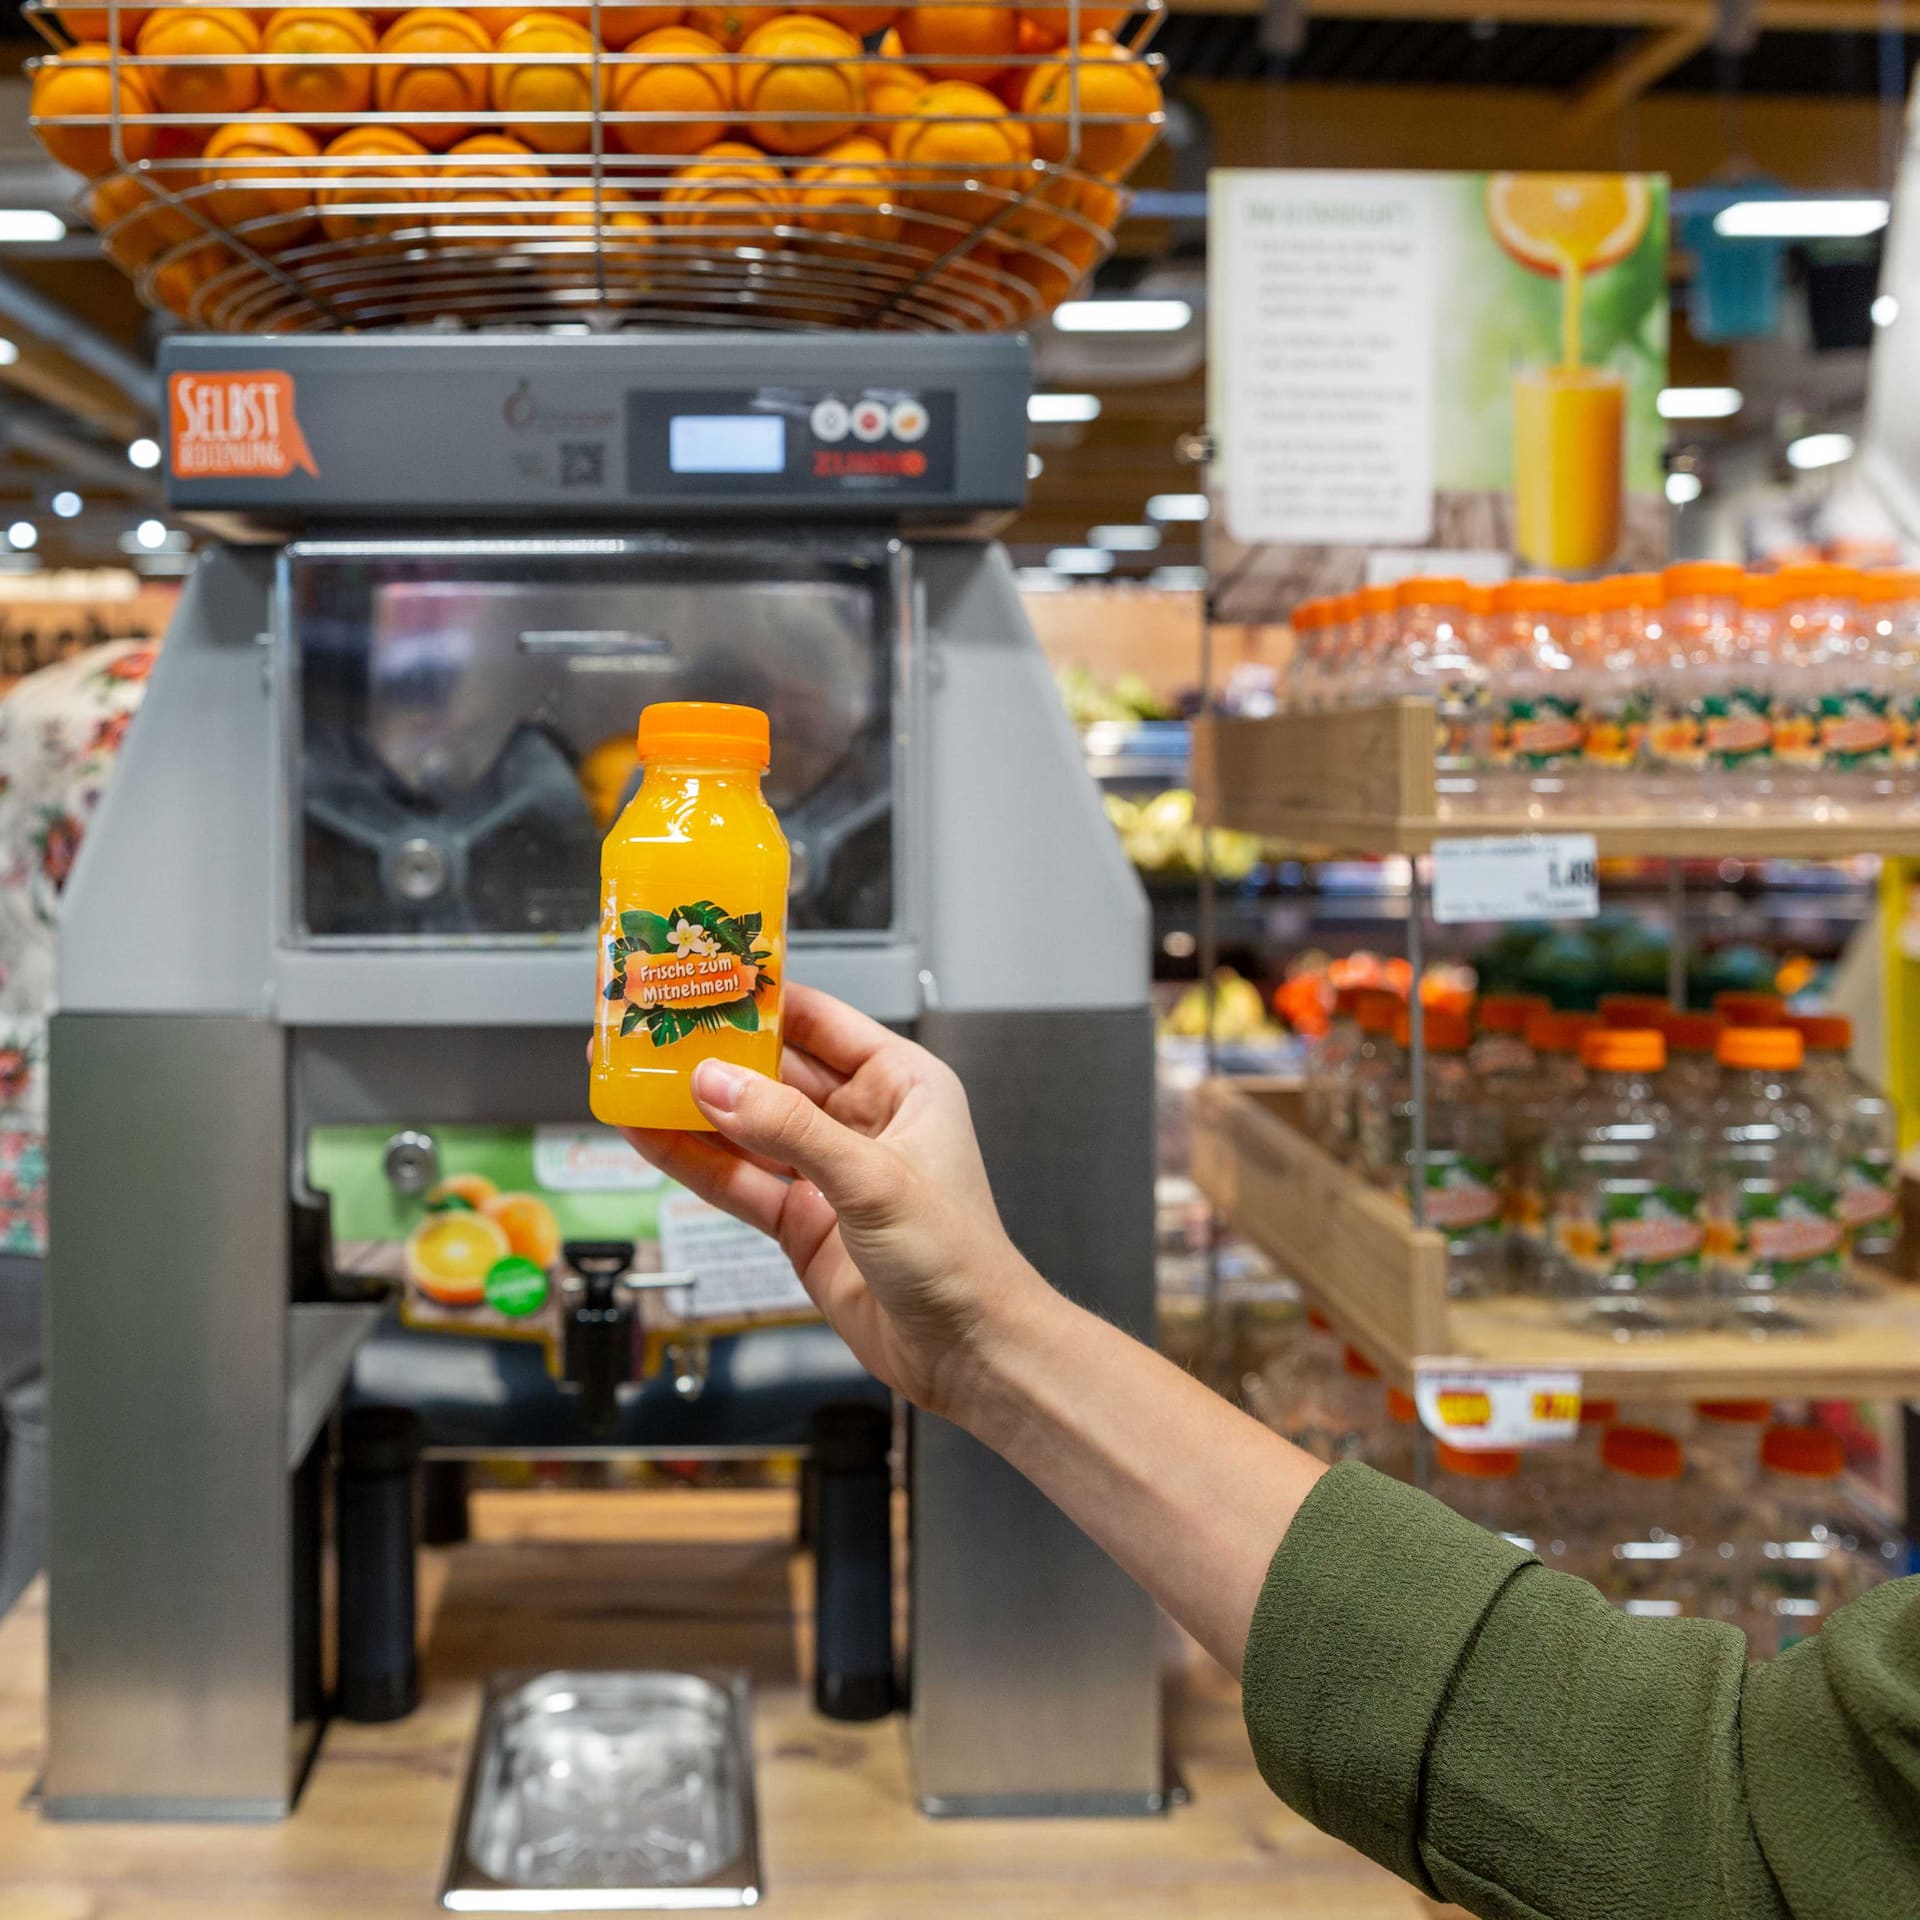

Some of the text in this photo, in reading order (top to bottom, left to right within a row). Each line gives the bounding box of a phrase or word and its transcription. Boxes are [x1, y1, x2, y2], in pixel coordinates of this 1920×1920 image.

[177, 377, 279, 442] SELBST
[640, 958, 732, 982] Frische zum
[643, 975, 739, 1003] Mitnehmen!
